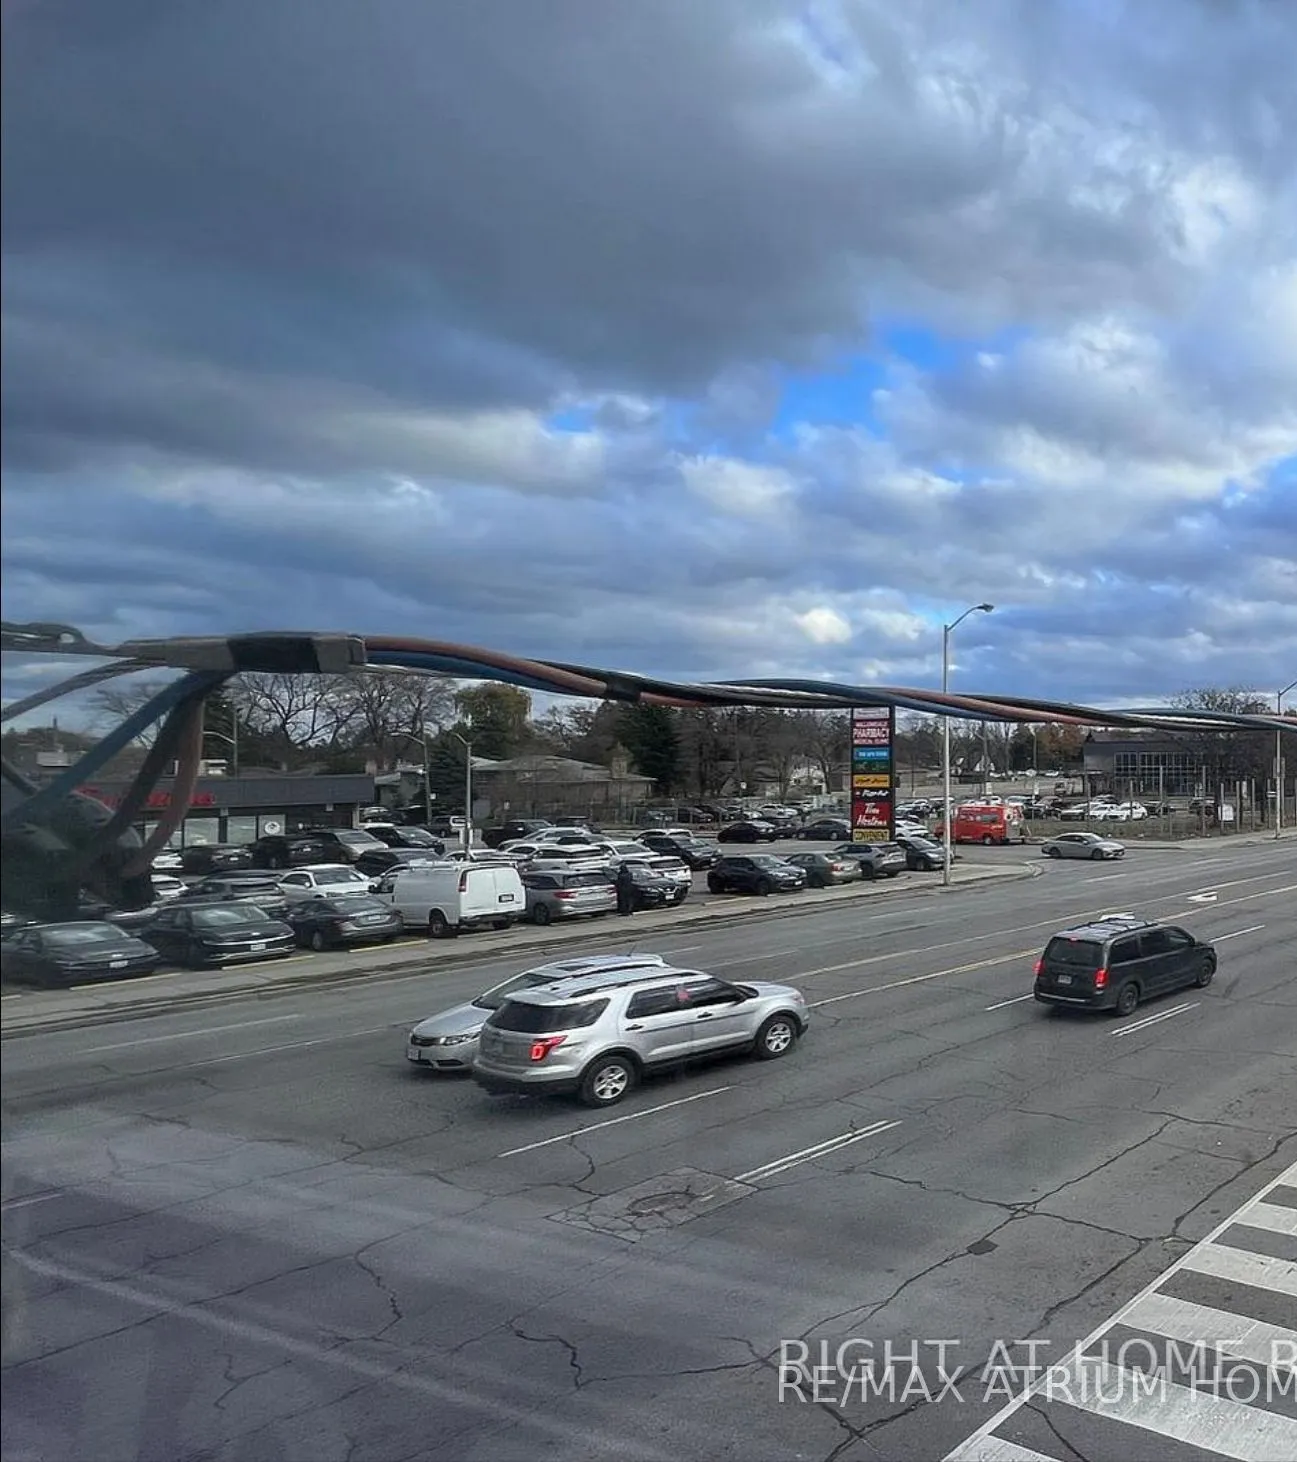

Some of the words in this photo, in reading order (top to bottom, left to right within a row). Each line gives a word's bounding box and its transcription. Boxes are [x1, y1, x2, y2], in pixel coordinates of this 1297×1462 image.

[853, 728, 890, 738] PHARMACY
[864, 802, 880, 815] Tim
[856, 814, 888, 827] Hortons
